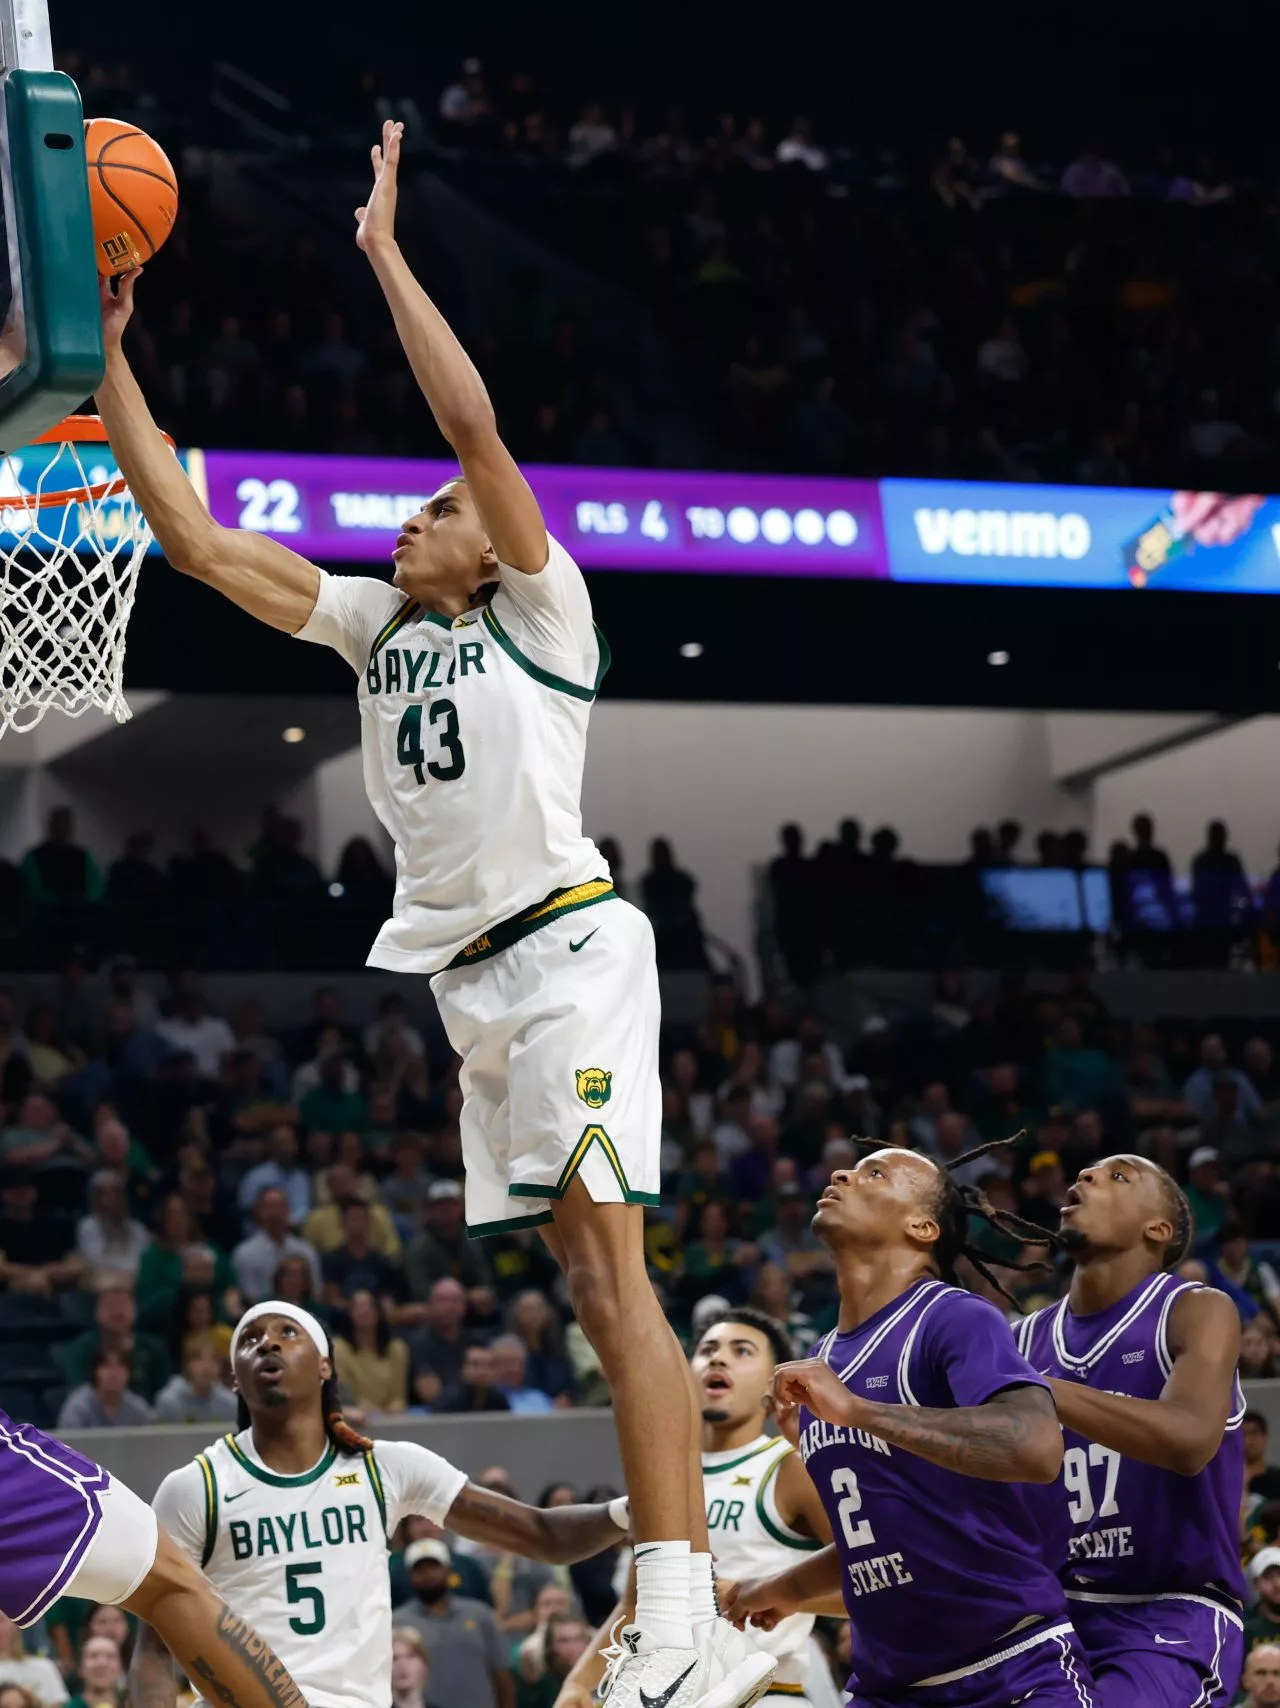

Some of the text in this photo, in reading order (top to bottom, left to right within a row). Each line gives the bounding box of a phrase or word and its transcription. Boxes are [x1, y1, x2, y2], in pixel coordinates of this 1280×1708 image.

[236, 478, 302, 533] 22
[914, 507, 1091, 560] venmo
[397, 698, 466, 785] 43
[865, 1375, 890, 1389] WAC
[1122, 1350, 1145, 1365] WAC
[830, 1467, 876, 1549] 2
[1064, 1443, 1121, 1524] 97
[229, 1504, 368, 1561] BAYLOR
[1068, 1526, 1134, 1561] STATE
[285, 1561, 326, 1636] 5
[848, 1552, 914, 1597] STATE
